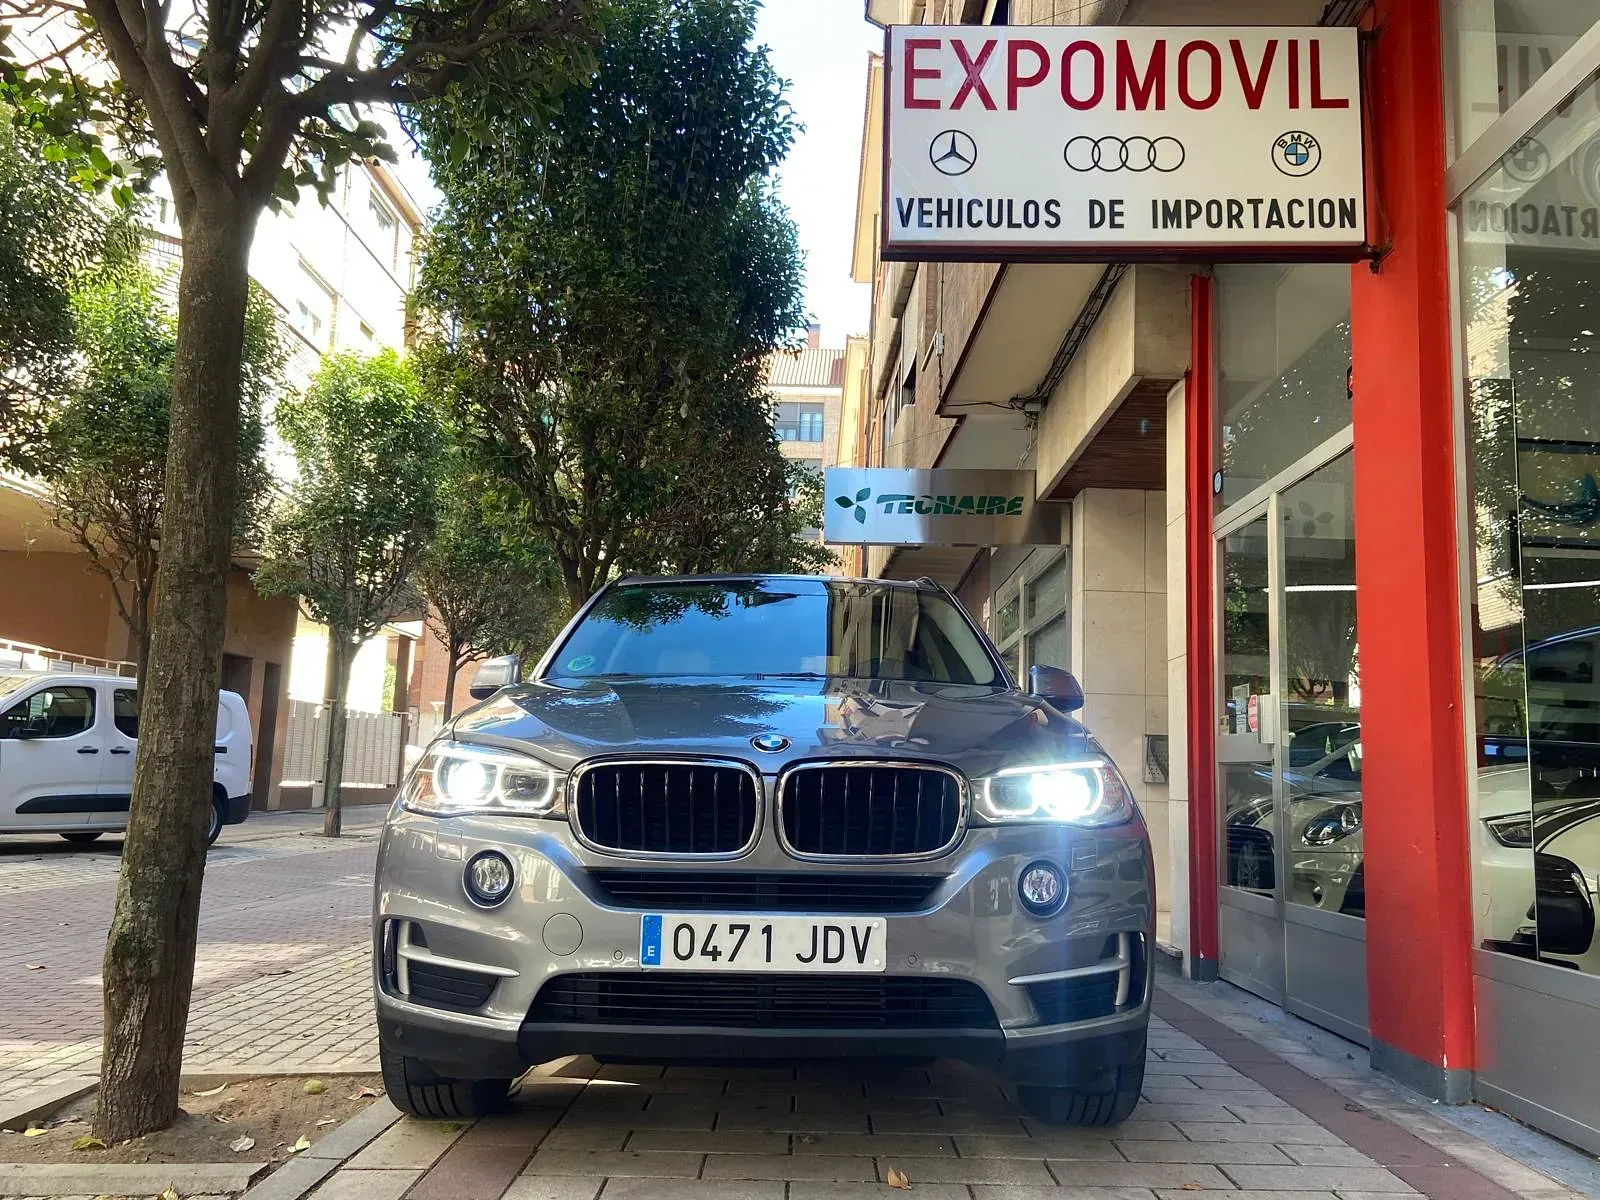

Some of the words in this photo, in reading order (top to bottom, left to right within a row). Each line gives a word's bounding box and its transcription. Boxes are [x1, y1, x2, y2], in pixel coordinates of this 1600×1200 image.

[903, 39, 1350, 111] EXPOMOVIL
[1276, 133, 1316, 150] BMW
[895, 197, 1061, 230] VEHICULOS
[1088, 199, 1125, 230] DE
[1151, 198, 1358, 230] IMPORTACION
[876, 493, 1024, 516] TECNAIRE
[647, 945, 656, 957] E
[673, 923, 773, 963] 0471
[795, 924, 873, 964] JDV
